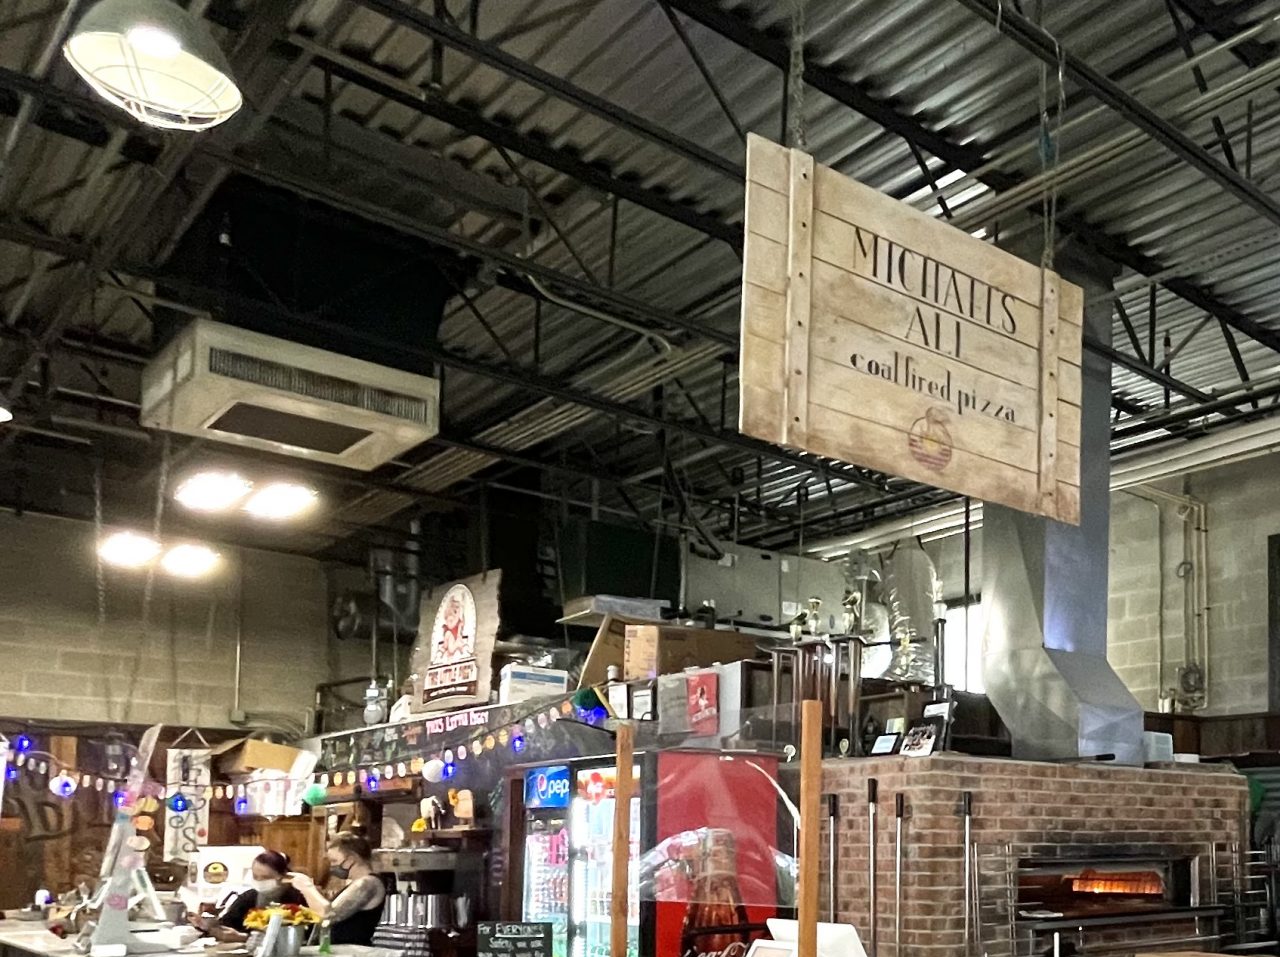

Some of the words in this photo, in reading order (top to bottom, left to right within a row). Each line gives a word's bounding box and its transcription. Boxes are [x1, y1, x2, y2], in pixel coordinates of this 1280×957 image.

[904, 306, 961, 359] ALI
[849, 351, 899, 385] coal
[904, 355, 951, 402] fired
[957, 388, 1016, 424] pizza
